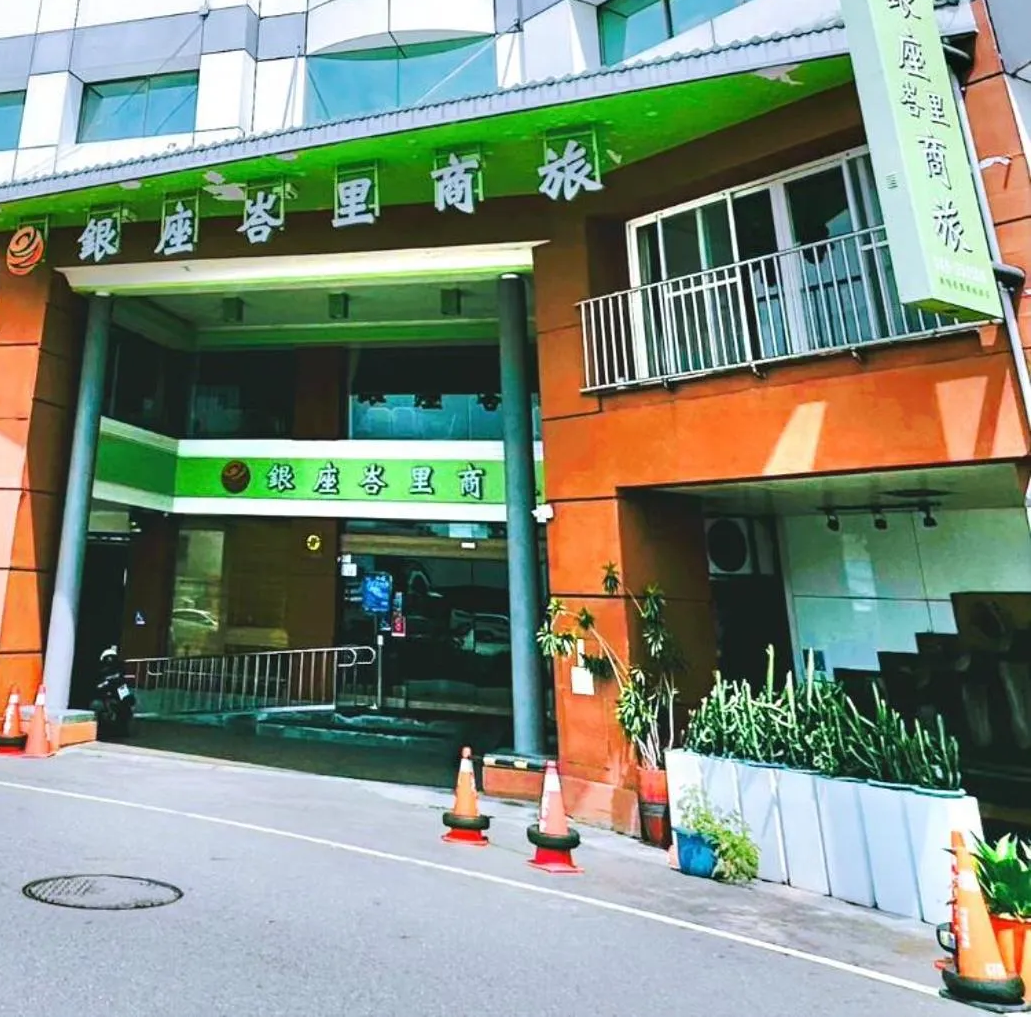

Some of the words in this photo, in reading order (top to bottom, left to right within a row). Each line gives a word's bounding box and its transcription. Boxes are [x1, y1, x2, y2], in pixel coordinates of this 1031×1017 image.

[78, 139, 603, 263] 銀座峇里商旅
[267, 461, 540, 501] 銀座峇里商
